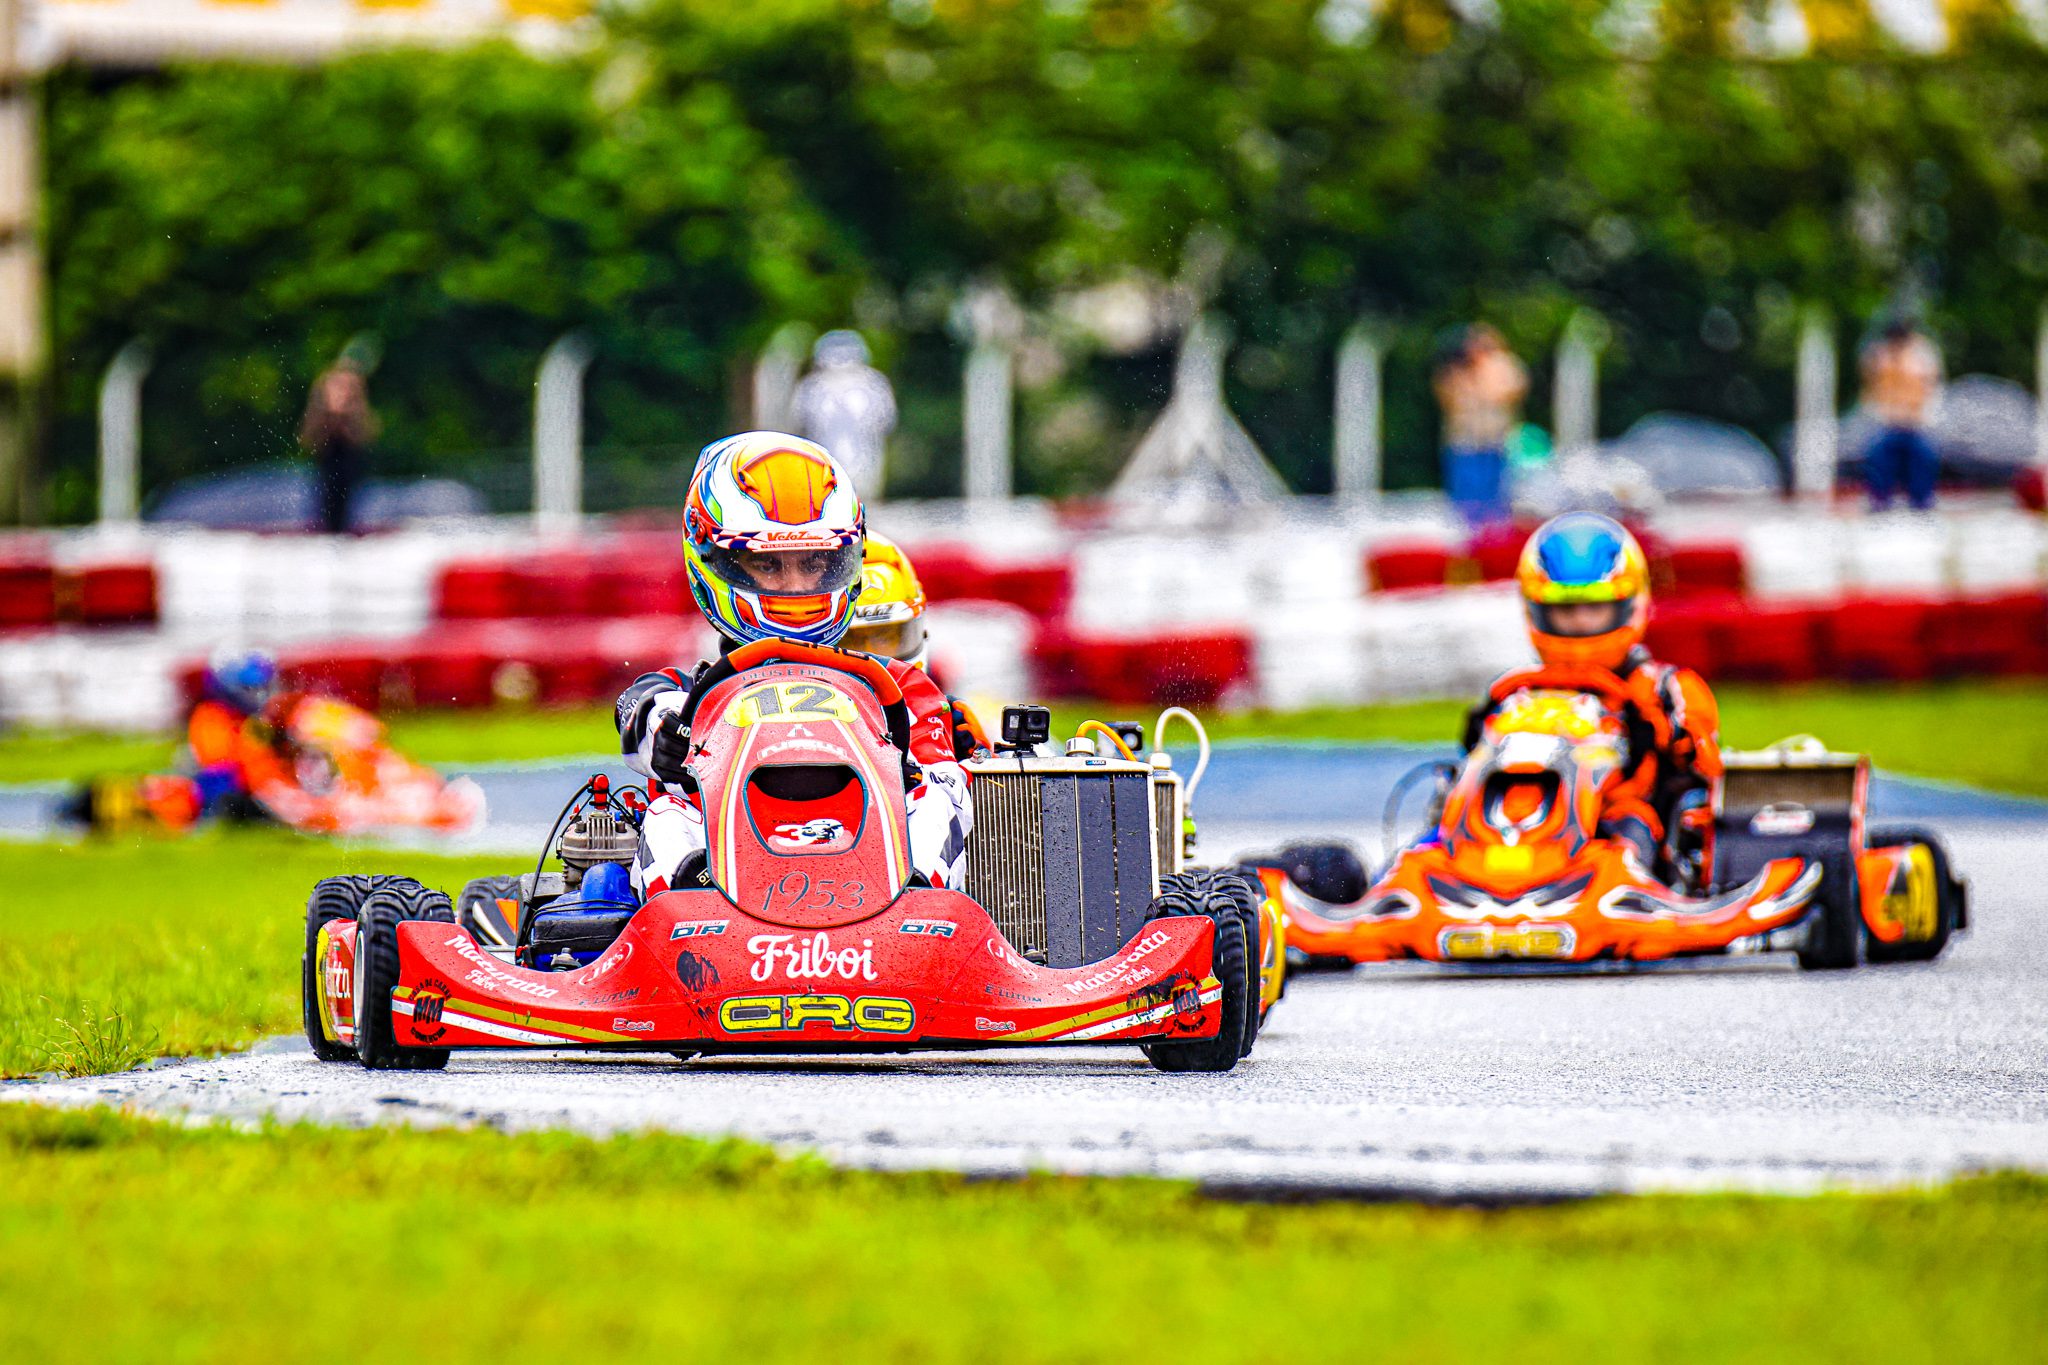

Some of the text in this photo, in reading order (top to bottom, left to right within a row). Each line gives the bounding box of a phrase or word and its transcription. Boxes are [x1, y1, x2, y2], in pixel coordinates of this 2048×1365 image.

[742, 685, 838, 718] 12
[762, 872, 865, 911] 1953
[444, 934, 559, 998] Maturatta
[747, 931, 878, 981] Friboi
[1063, 930, 1172, 995] Maturatta
[719, 994, 915, 1034] CRG
